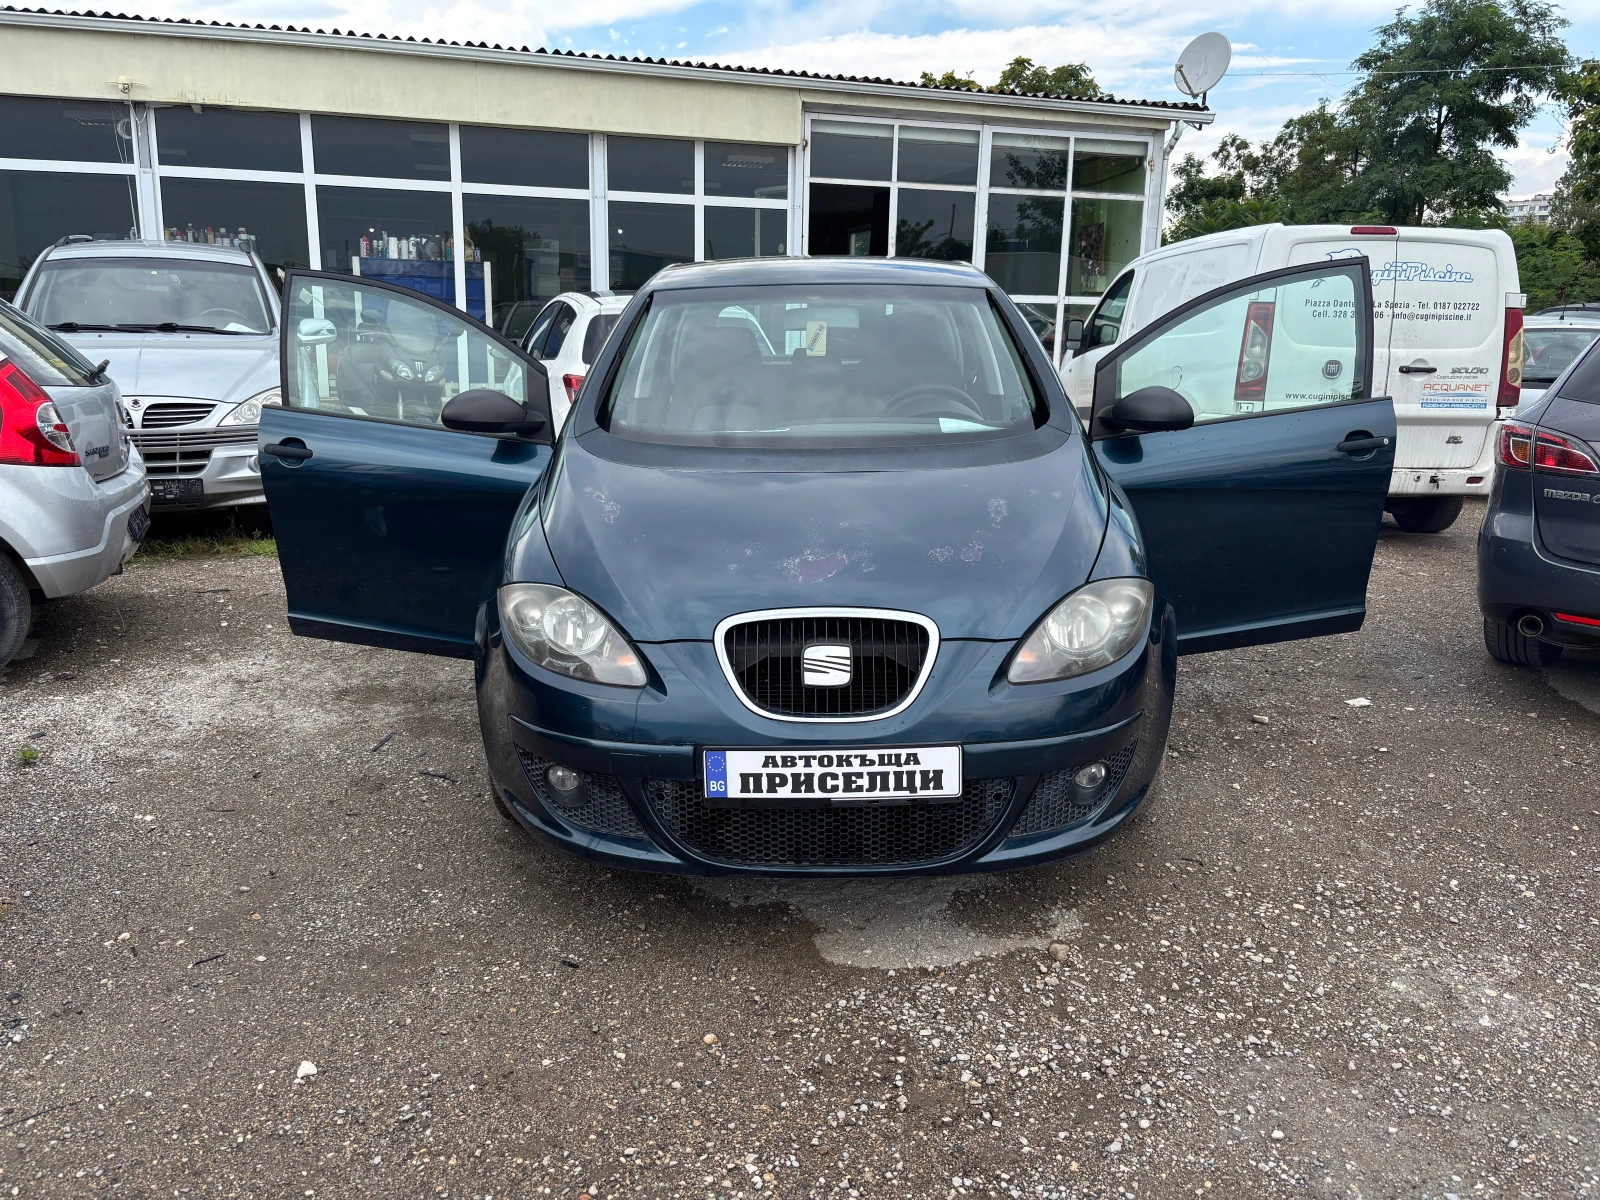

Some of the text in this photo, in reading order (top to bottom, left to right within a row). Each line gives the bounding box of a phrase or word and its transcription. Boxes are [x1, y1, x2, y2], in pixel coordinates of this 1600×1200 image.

[1304, 299, 1355, 308] Piazza Dante
[1384, 301, 1410, 310] Spezia
[1418, 302, 1431, 310] Tel.
[1433, 302, 1451, 310] 0187
[1453, 302, 1480, 311] 022722
[1312, 310, 1330, 318] Cell.
[1332, 311, 1348, 319] 328
[1392, 312, 1472, 322] info@cuginipiscine.it
[1327, 364, 1339, 374] FIAT
[1423, 383, 1491, 393] ACQUANET
[761, 752, 922, 768] АВТОКЪЩА
[709, 780, 726, 792] BG
[739, 769, 945, 794] ПРИСЕЛЦИ
